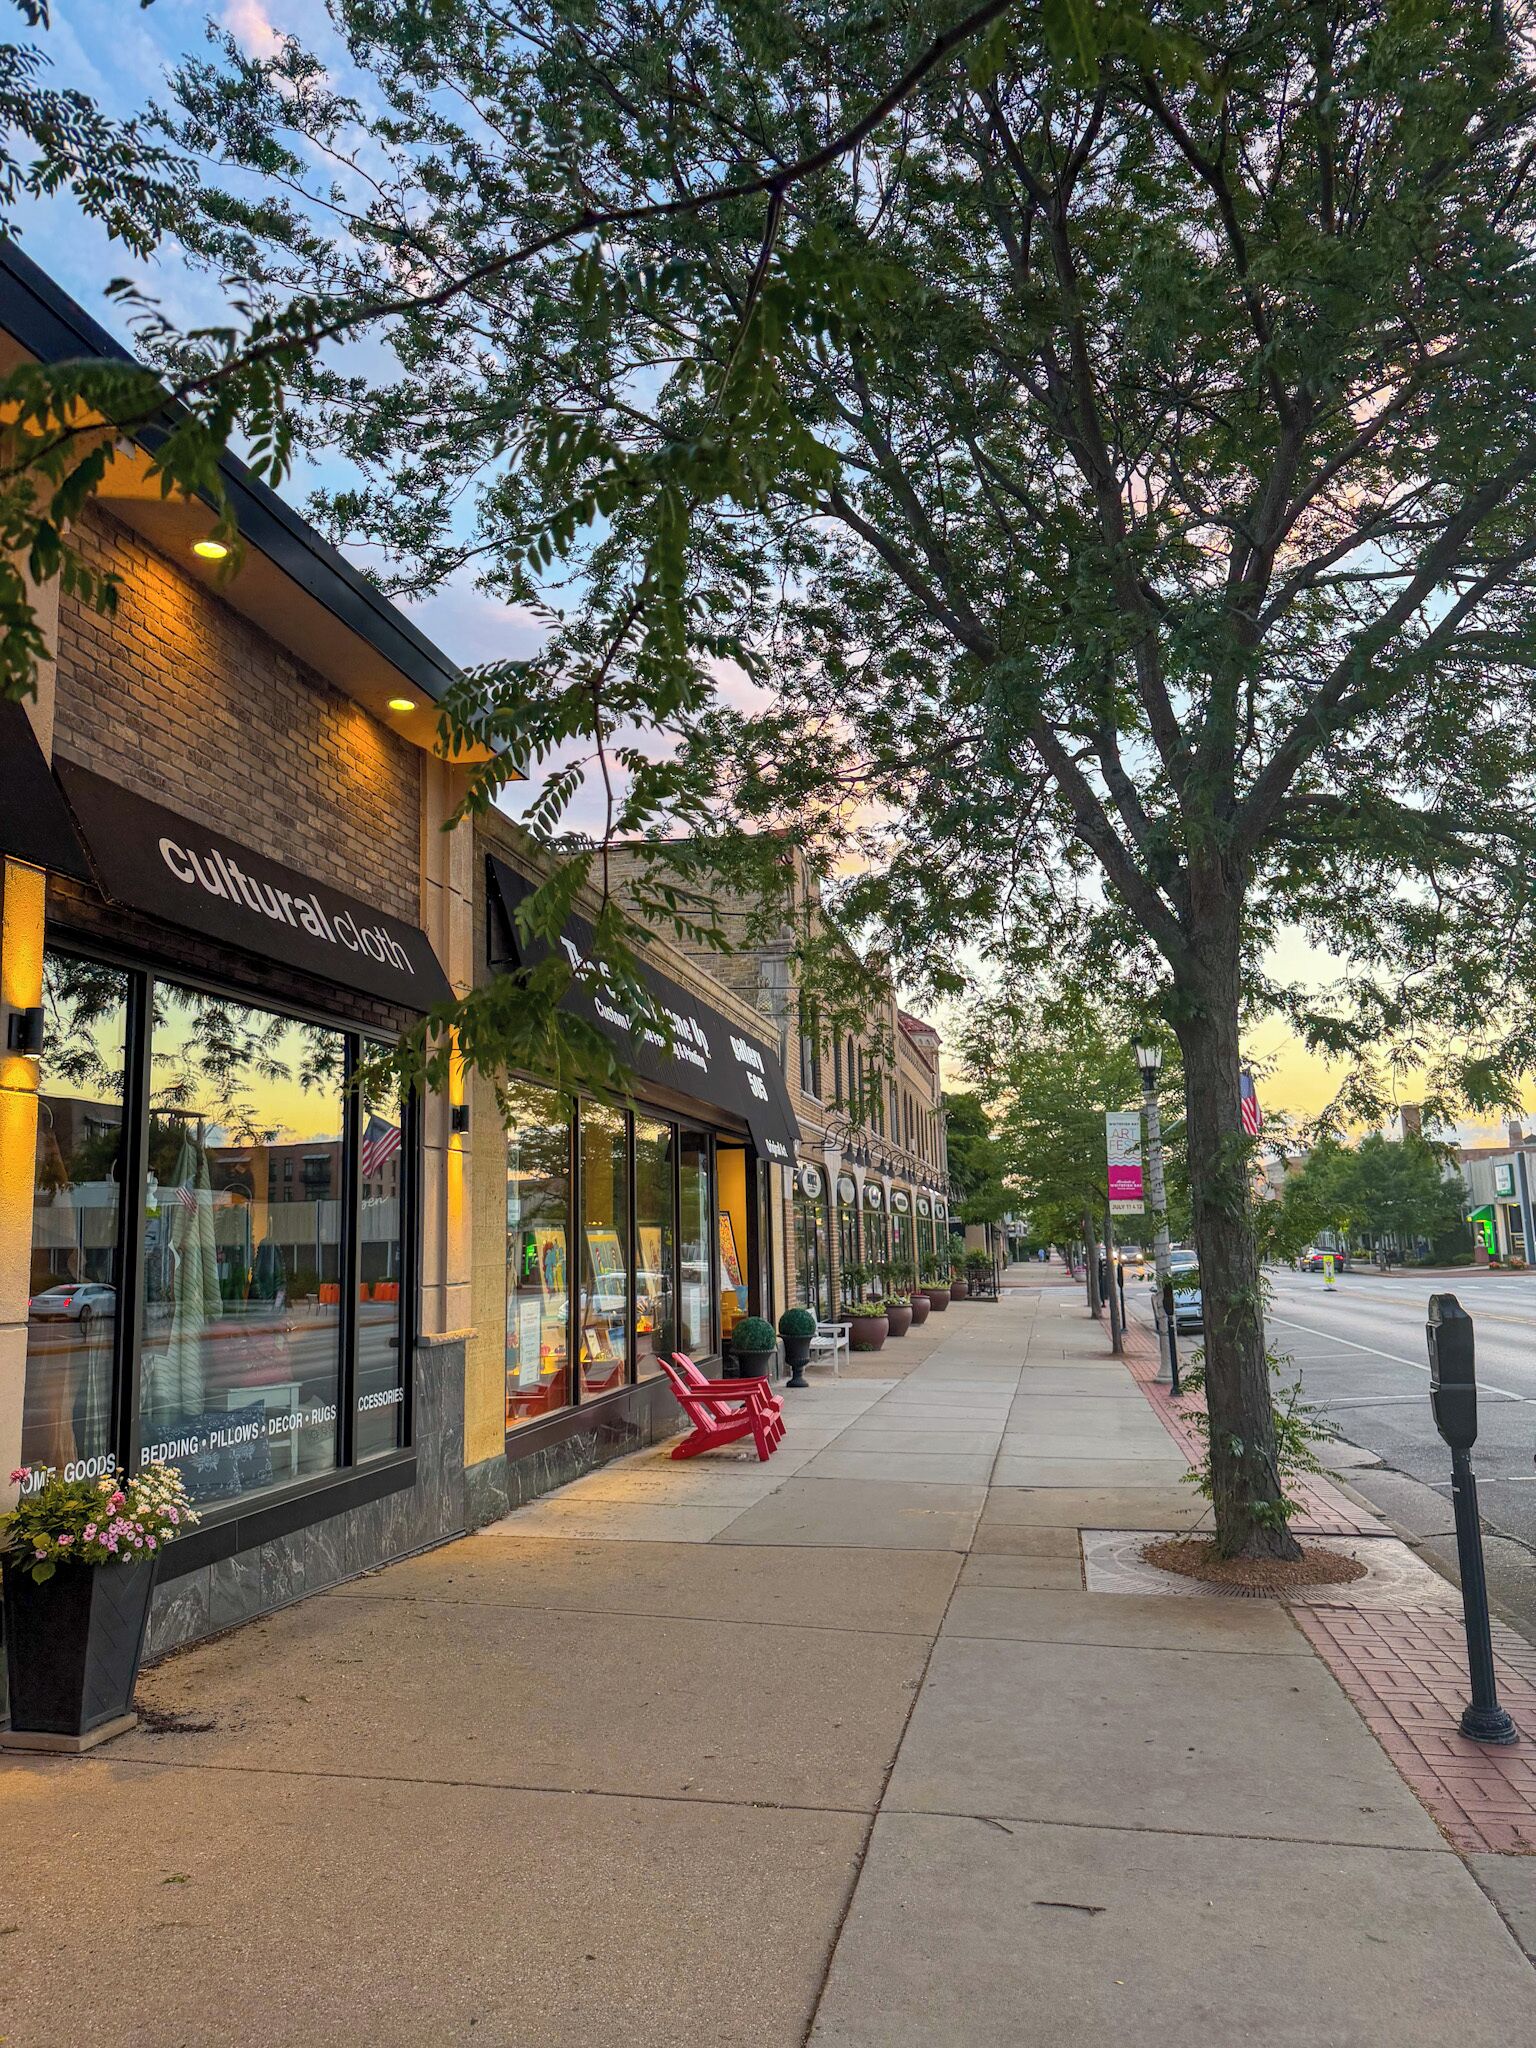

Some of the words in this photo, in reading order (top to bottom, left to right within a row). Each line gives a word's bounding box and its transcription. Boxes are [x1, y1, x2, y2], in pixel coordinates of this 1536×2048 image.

[158, 837, 337, 944] cultural
[333, 910, 415, 975] cloth
[1109, 1139, 1133, 1151] FES
[1112, 1128, 1137, 1139] ART
[357, 1387, 404, 1412] CCESSORIES
[140, 1436, 199, 1467] BEDDING
[210, 1421, 259, 1450] PILLOWS
[268, 1411, 303, 1437] DECOR
[311, 1404, 338, 1426] RUGS
[64, 1453, 116, 1484] GOODS
